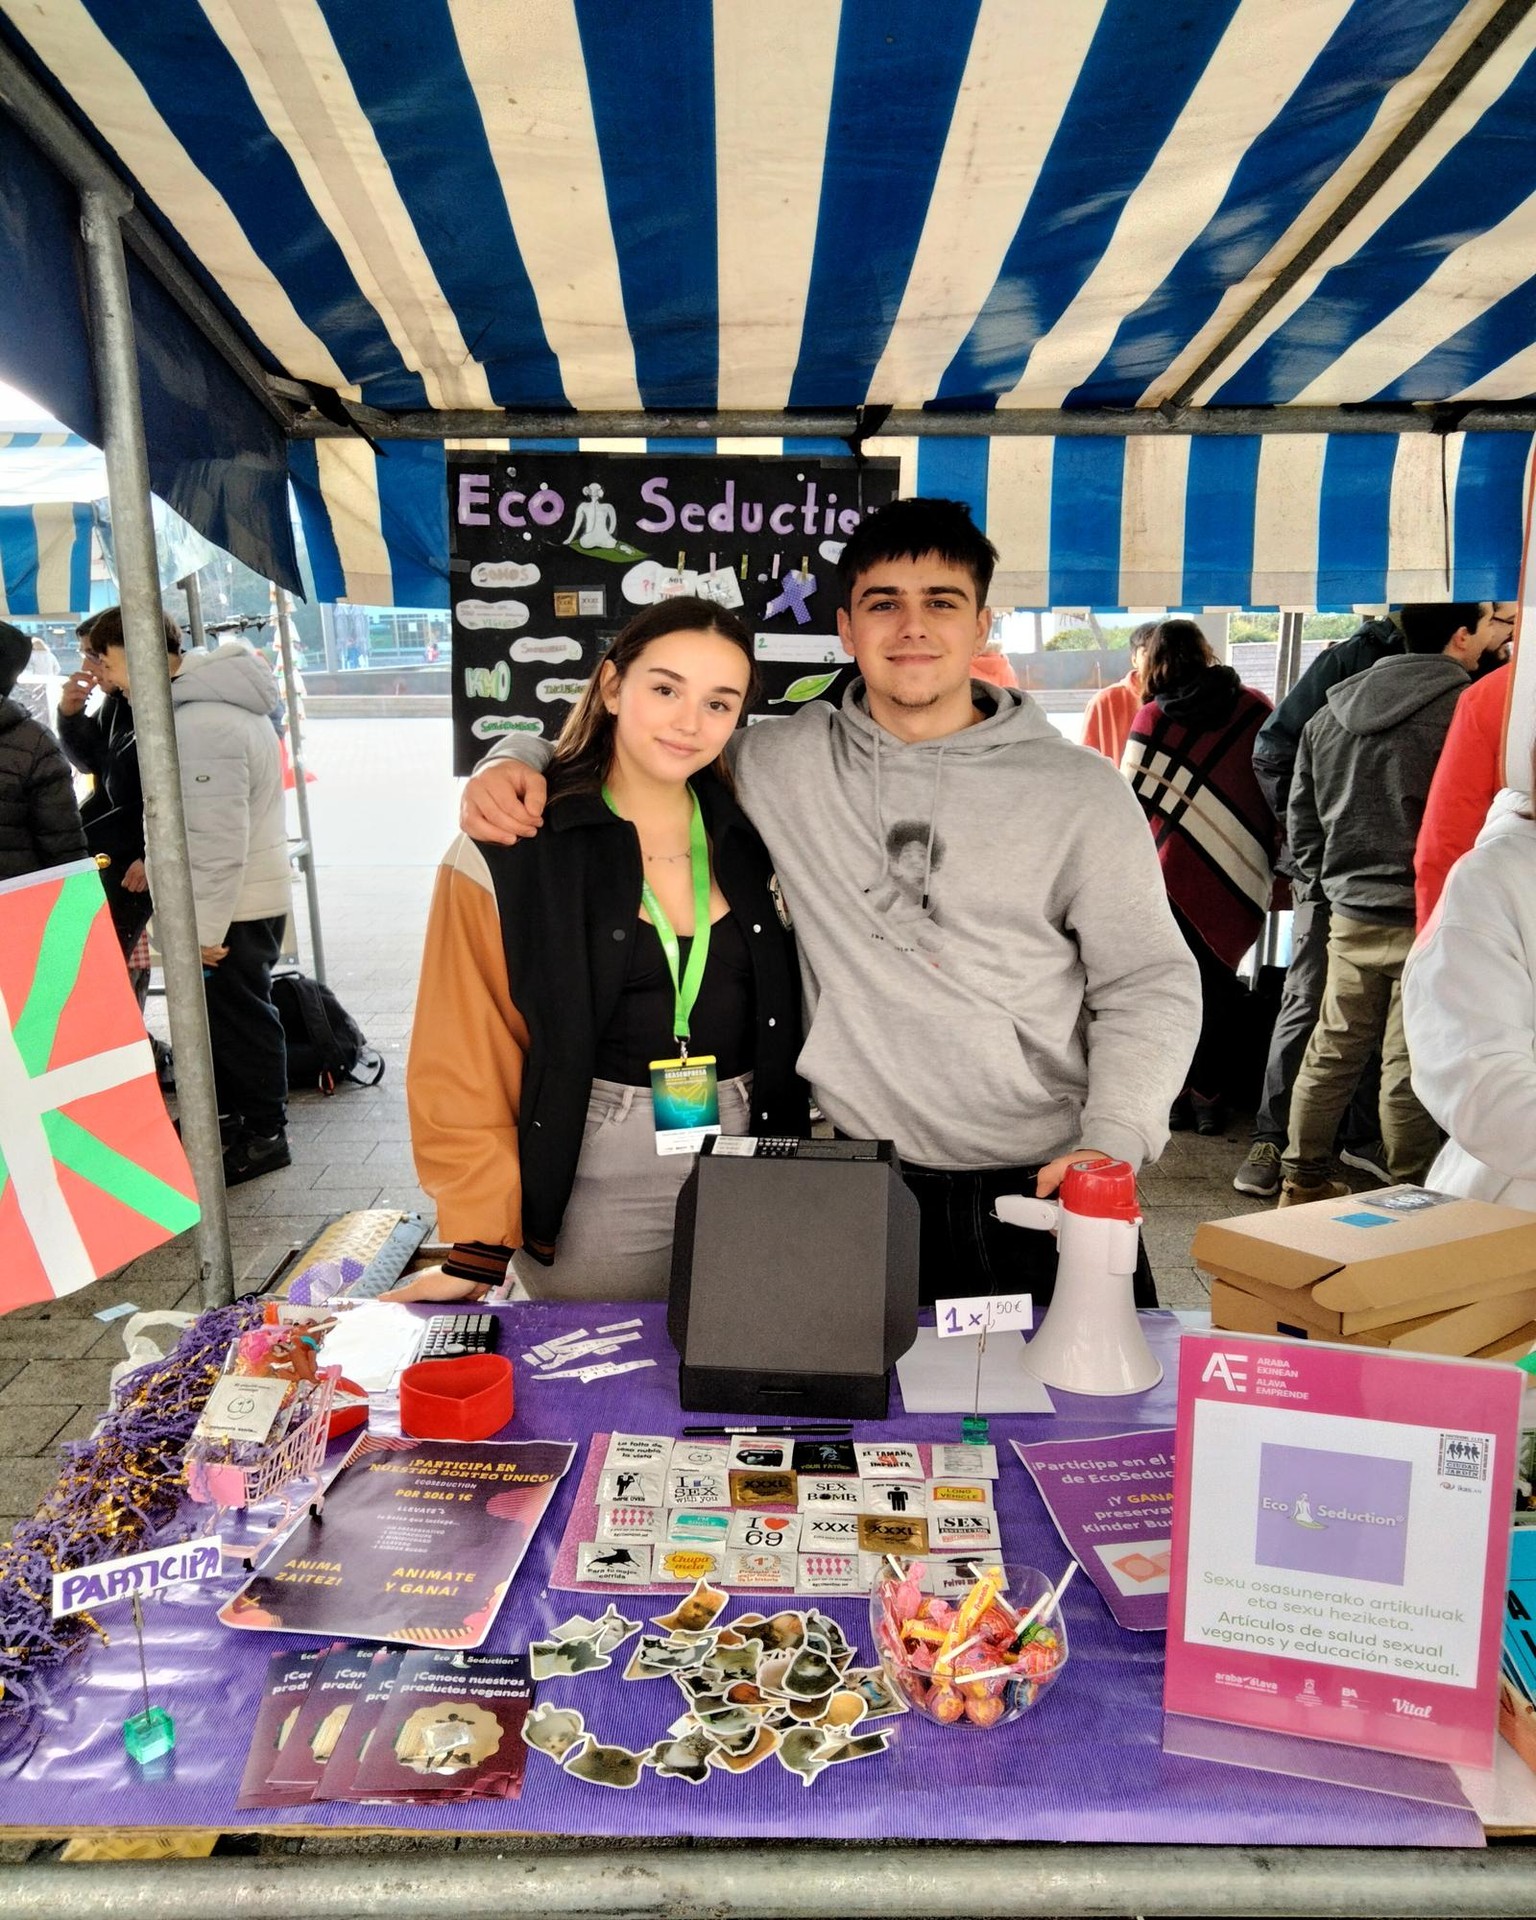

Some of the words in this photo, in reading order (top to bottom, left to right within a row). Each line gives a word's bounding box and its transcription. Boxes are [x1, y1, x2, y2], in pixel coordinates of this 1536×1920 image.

[458, 474, 565, 527] Eco
[636, 477, 879, 535] Seductio
[1257, 1357, 1290, 1368] ARABA
[1256, 1366, 1299, 1378] EKINEAN
[1255, 1387, 1309, 1400] EMPRENDE
[1122, 1459, 1145, 1467] en
[1150, 1454, 1167, 1465] el
[370, 1463, 438, 1476] NUESTRO
[440, 1470, 498, 1481] SORTEO
[495, 1463, 517, 1472] EN
[415, 1479, 477, 1489] ECOSEDUCTION
[676, 1476, 689, 1487] I
[1061, 1474, 1085, 1484] de
[675, 1486, 718, 1498] SEX
[815, 1483, 847, 1491] SEX
[394, 1489, 420, 1498] POR
[423, 1491, 452, 1500] SOLO
[700, 1496, 718, 1504] you
[1262, 1497, 1289, 1513] Eco
[748, 1516, 762, 1529] I
[944, 1517, 983, 1527] SEX
[1082, 1521, 1140, 1533] Kinder
[745, 1530, 783, 1547] 69
[284, 1559, 343, 1572] ANIMA
[672, 1555, 711, 1565] Chupa
[275, 1572, 343, 1586] ZAITEZ!
[392, 1567, 476, 1583] ANIMATE
[383, 1582, 398, 1592] Y
[400, 1583, 460, 1597] GANA!
[1203, 1571, 1245, 1590] Sexu
[1251, 1582, 1365, 1607] osasunerako
[1370, 1600, 1465, 1623] artikuluak
[1247, 1597, 1277, 1610] eta
[1283, 1602, 1323, 1618] sexu
[1329, 1607, 1414, 1632] heziketa.
[1218, 1611, 1294, 1634] Artículos
[1299, 1623, 1322, 1638] de
[1328, 1630, 1377, 1647] salud
[1383, 1638, 1443, 1658] sexual
[357, 1650, 373, 1658] Eco
[1201, 1626, 1275, 1647] veganos
[1279, 1638, 1290, 1652] y
[1294, 1640, 1388, 1665] educación
[1394, 1656, 1460, 1677] sexual.
[414, 1671, 466, 1683] ¡Conoce
[469, 1676, 525, 1686] nuestros
[400, 1684, 466, 1695] productos
[470, 1688, 530, 1698] veganos!
[1392, 1698, 1432, 1719] Vital
